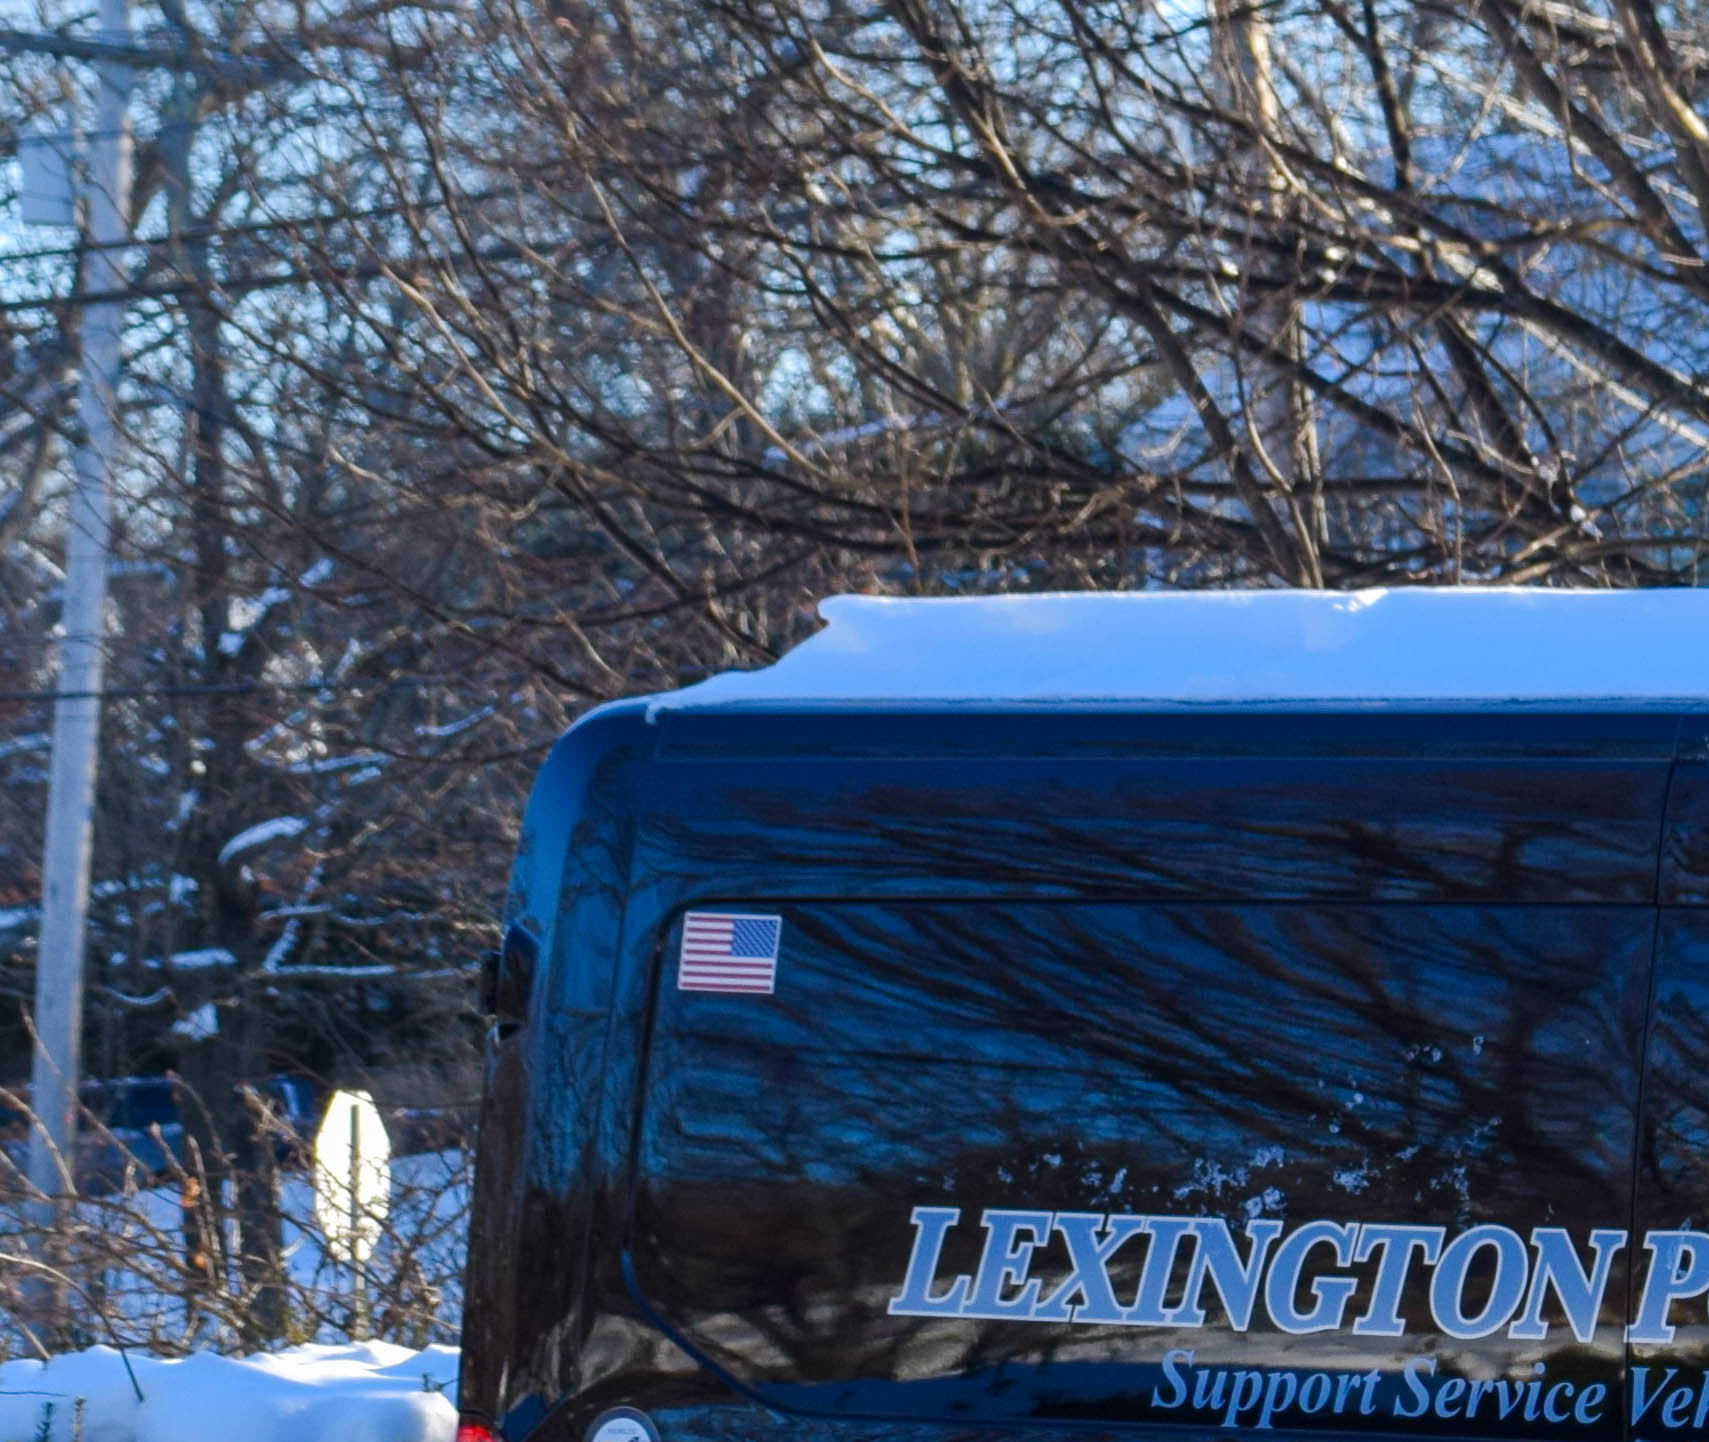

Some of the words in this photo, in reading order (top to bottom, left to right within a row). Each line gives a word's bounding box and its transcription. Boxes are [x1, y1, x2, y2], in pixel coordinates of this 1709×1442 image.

[887, 1206, 1629, 1344] LEXINGTON
[1150, 1348, 1381, 1429] Support
[1392, 1355, 1606, 1424] Service
